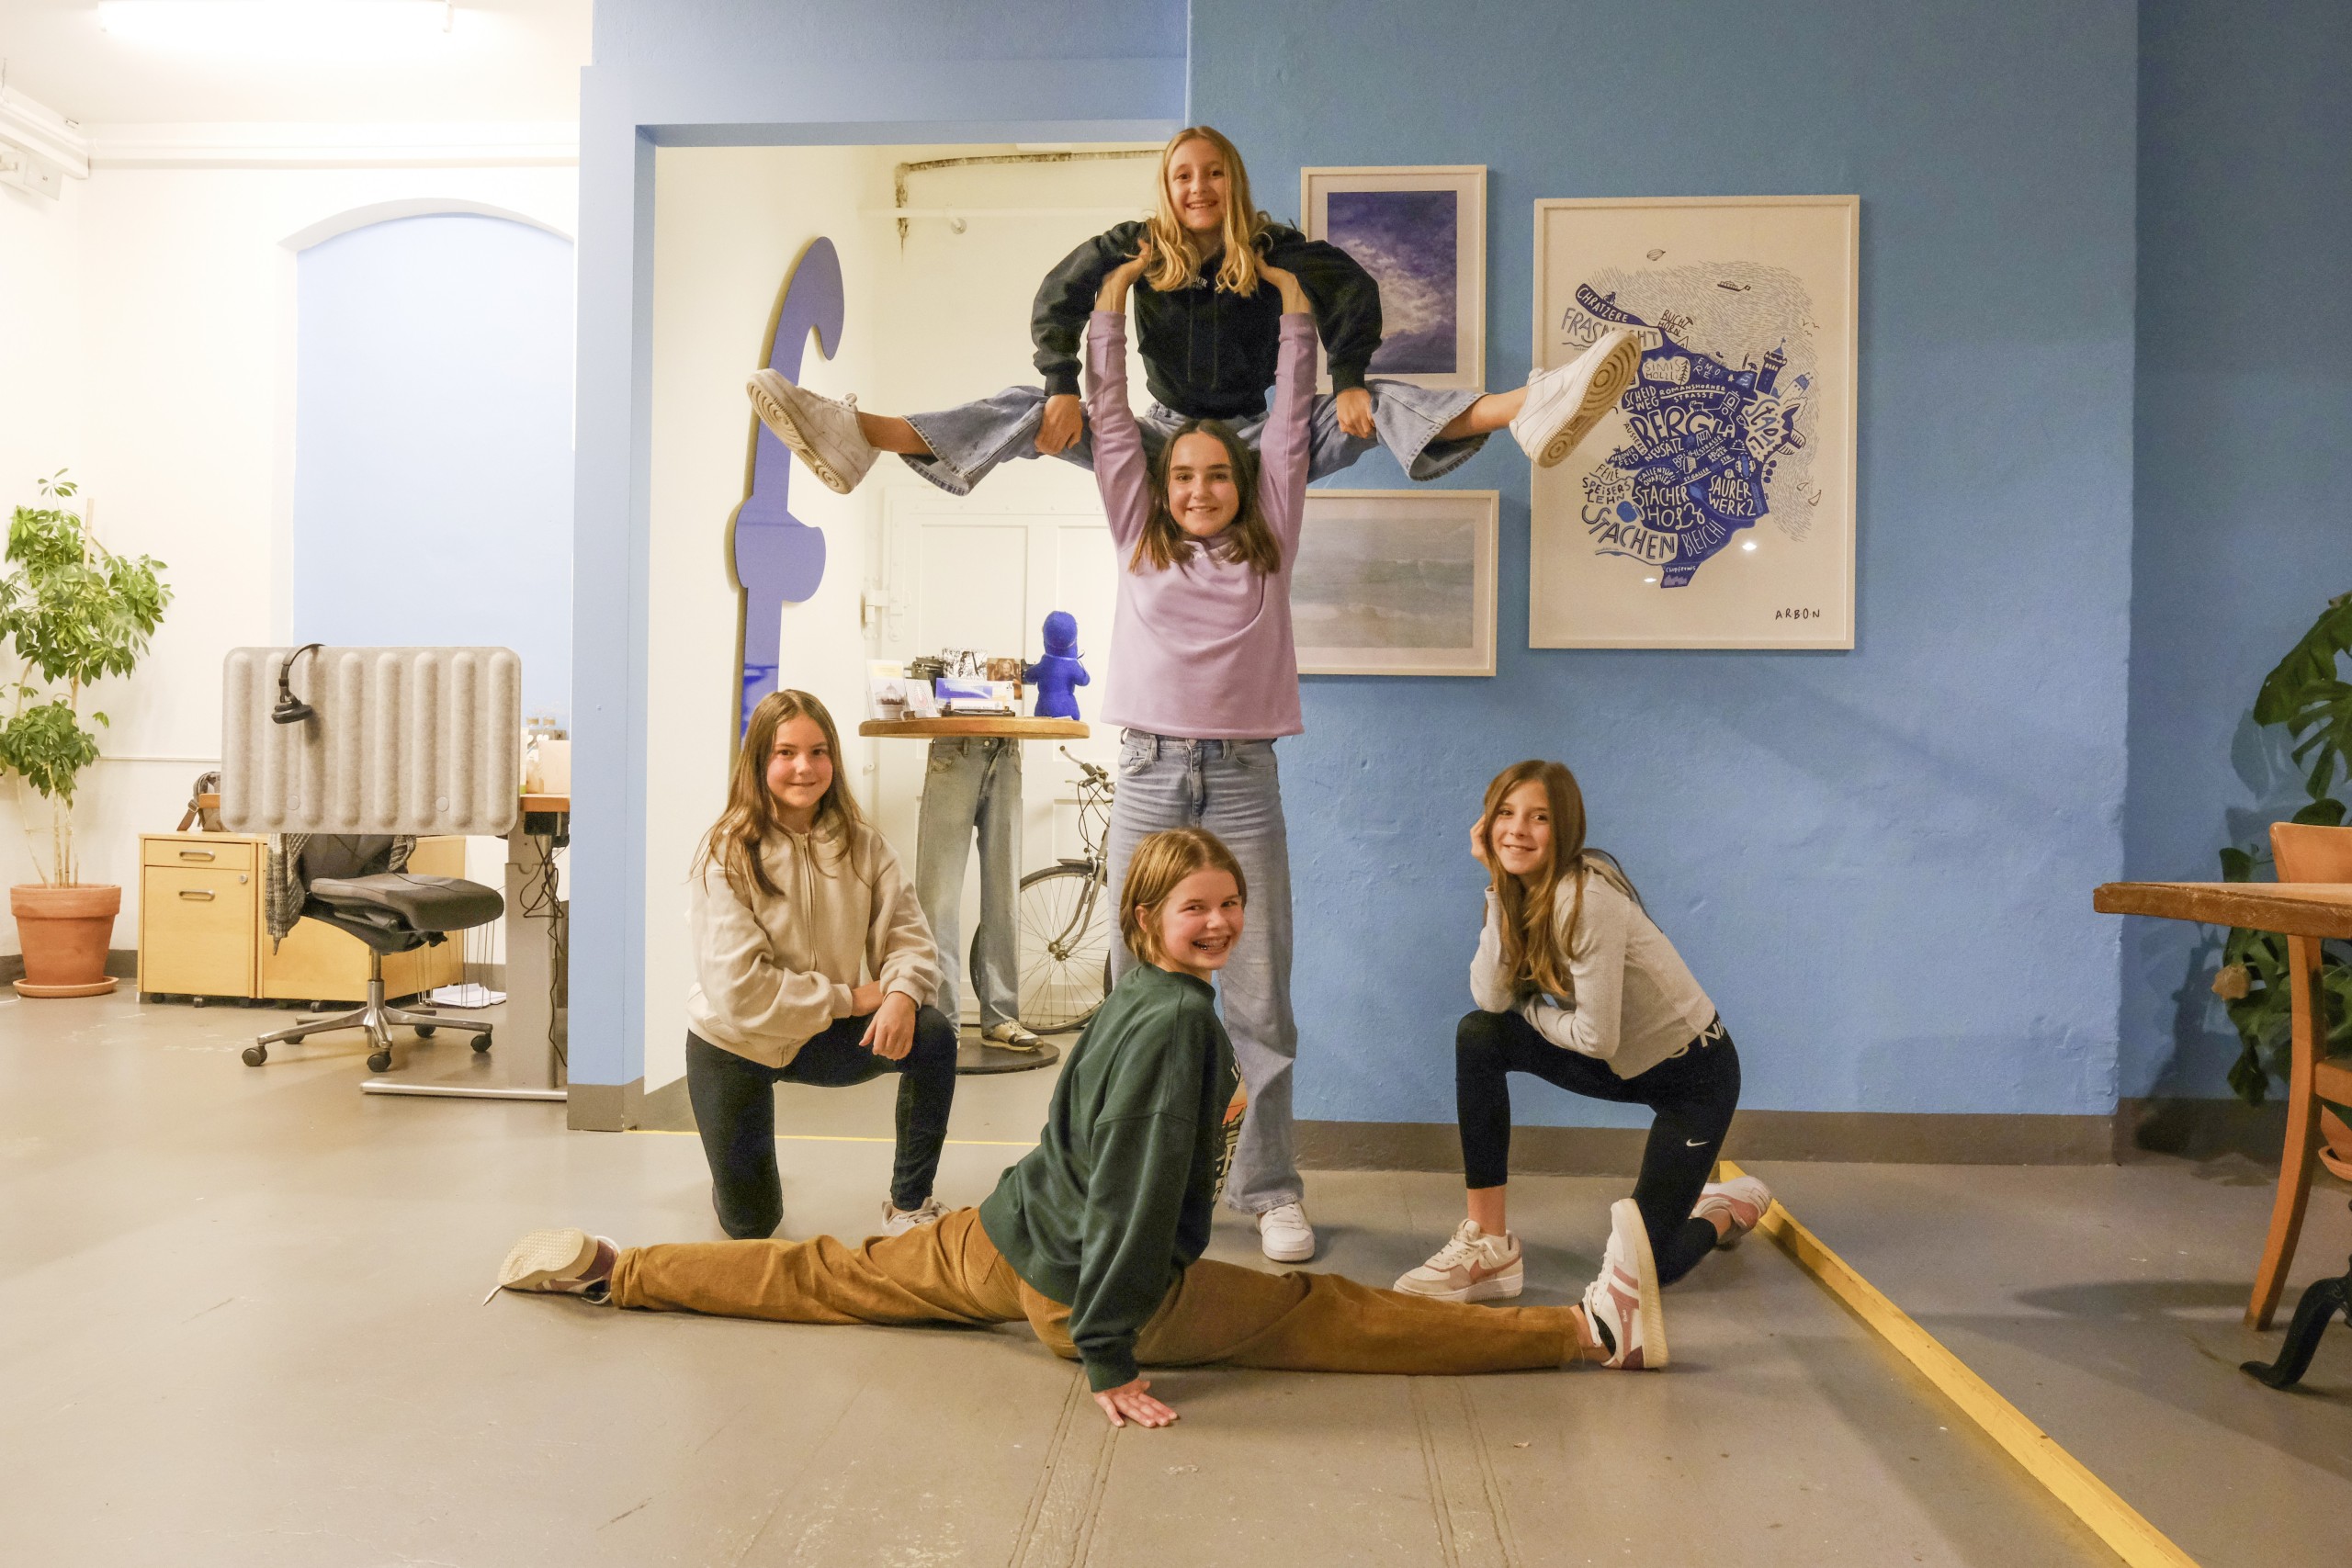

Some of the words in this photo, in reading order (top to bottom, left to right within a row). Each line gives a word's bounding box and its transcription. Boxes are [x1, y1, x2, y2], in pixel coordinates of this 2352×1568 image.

[1577, 288, 1628, 323] CHRATZERE
[1561, 307, 1657, 347] FRASHT
[1657, 321, 1680, 336] HORN
[1624, 386, 1657, 407] SCHEID
[1659, 384, 1725, 396] ROMANSHORNER
[1673, 392, 1713, 403] STRASSE
[1635, 396, 1659, 411] WEG
[1618, 453, 1639, 467] FELD
[1585, 489, 1624, 504] LEHN
[1633, 485, 1690, 508] STACHER
[1708, 475, 1751, 501] SAURER
[1582, 504, 1675, 559] STACHEN
